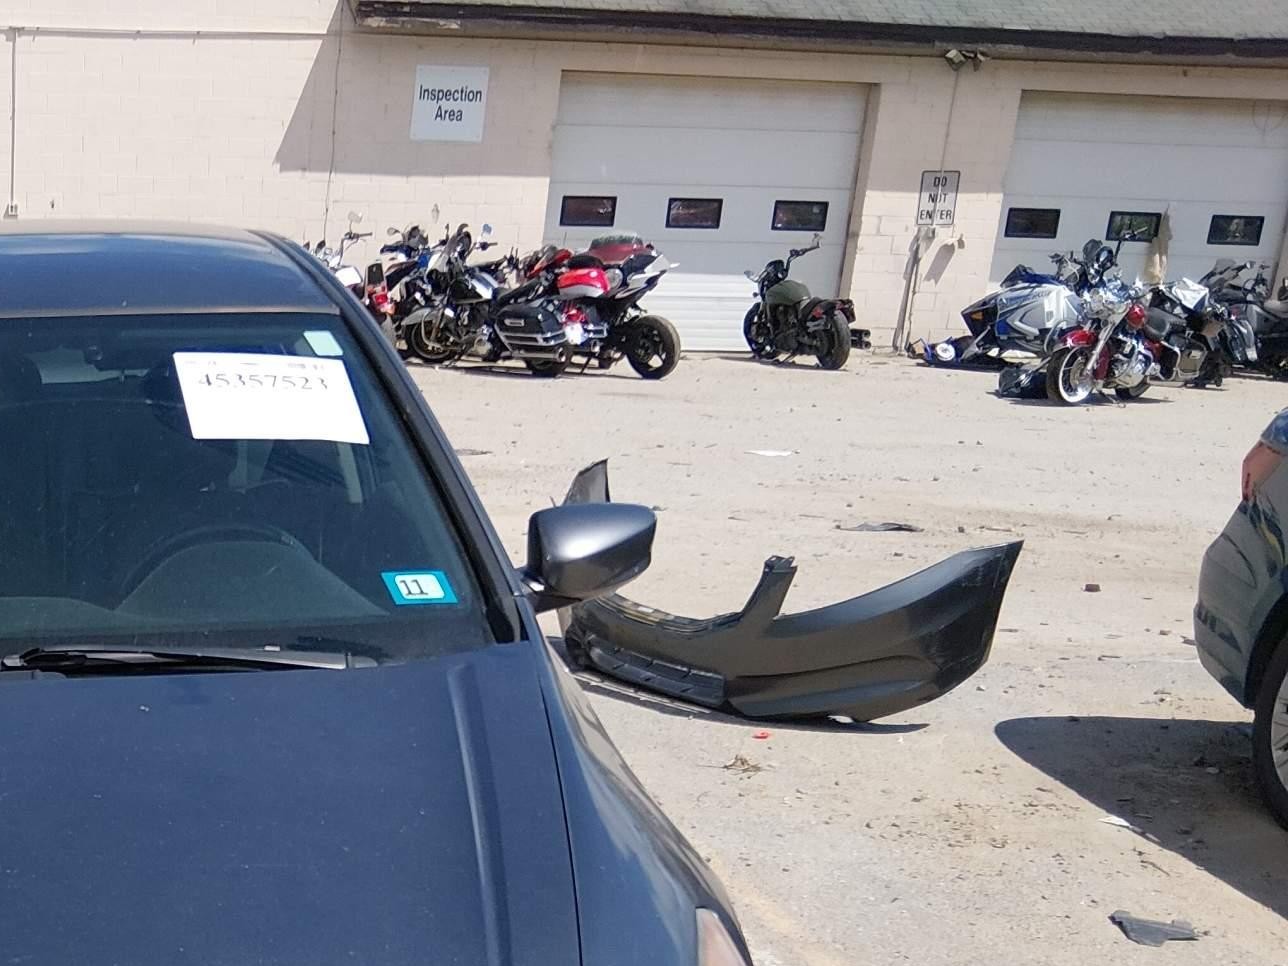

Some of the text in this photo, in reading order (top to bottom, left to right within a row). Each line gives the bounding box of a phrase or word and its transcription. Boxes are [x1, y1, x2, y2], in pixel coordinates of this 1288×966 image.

[418, 84, 483, 104] Inspection
[434, 105, 464, 122] Area
[933, 176, 948, 188] DO
[919, 209, 953, 220] ENER
[198, 373, 329, 391] 45357523
[399, 579, 429, 597] 11
